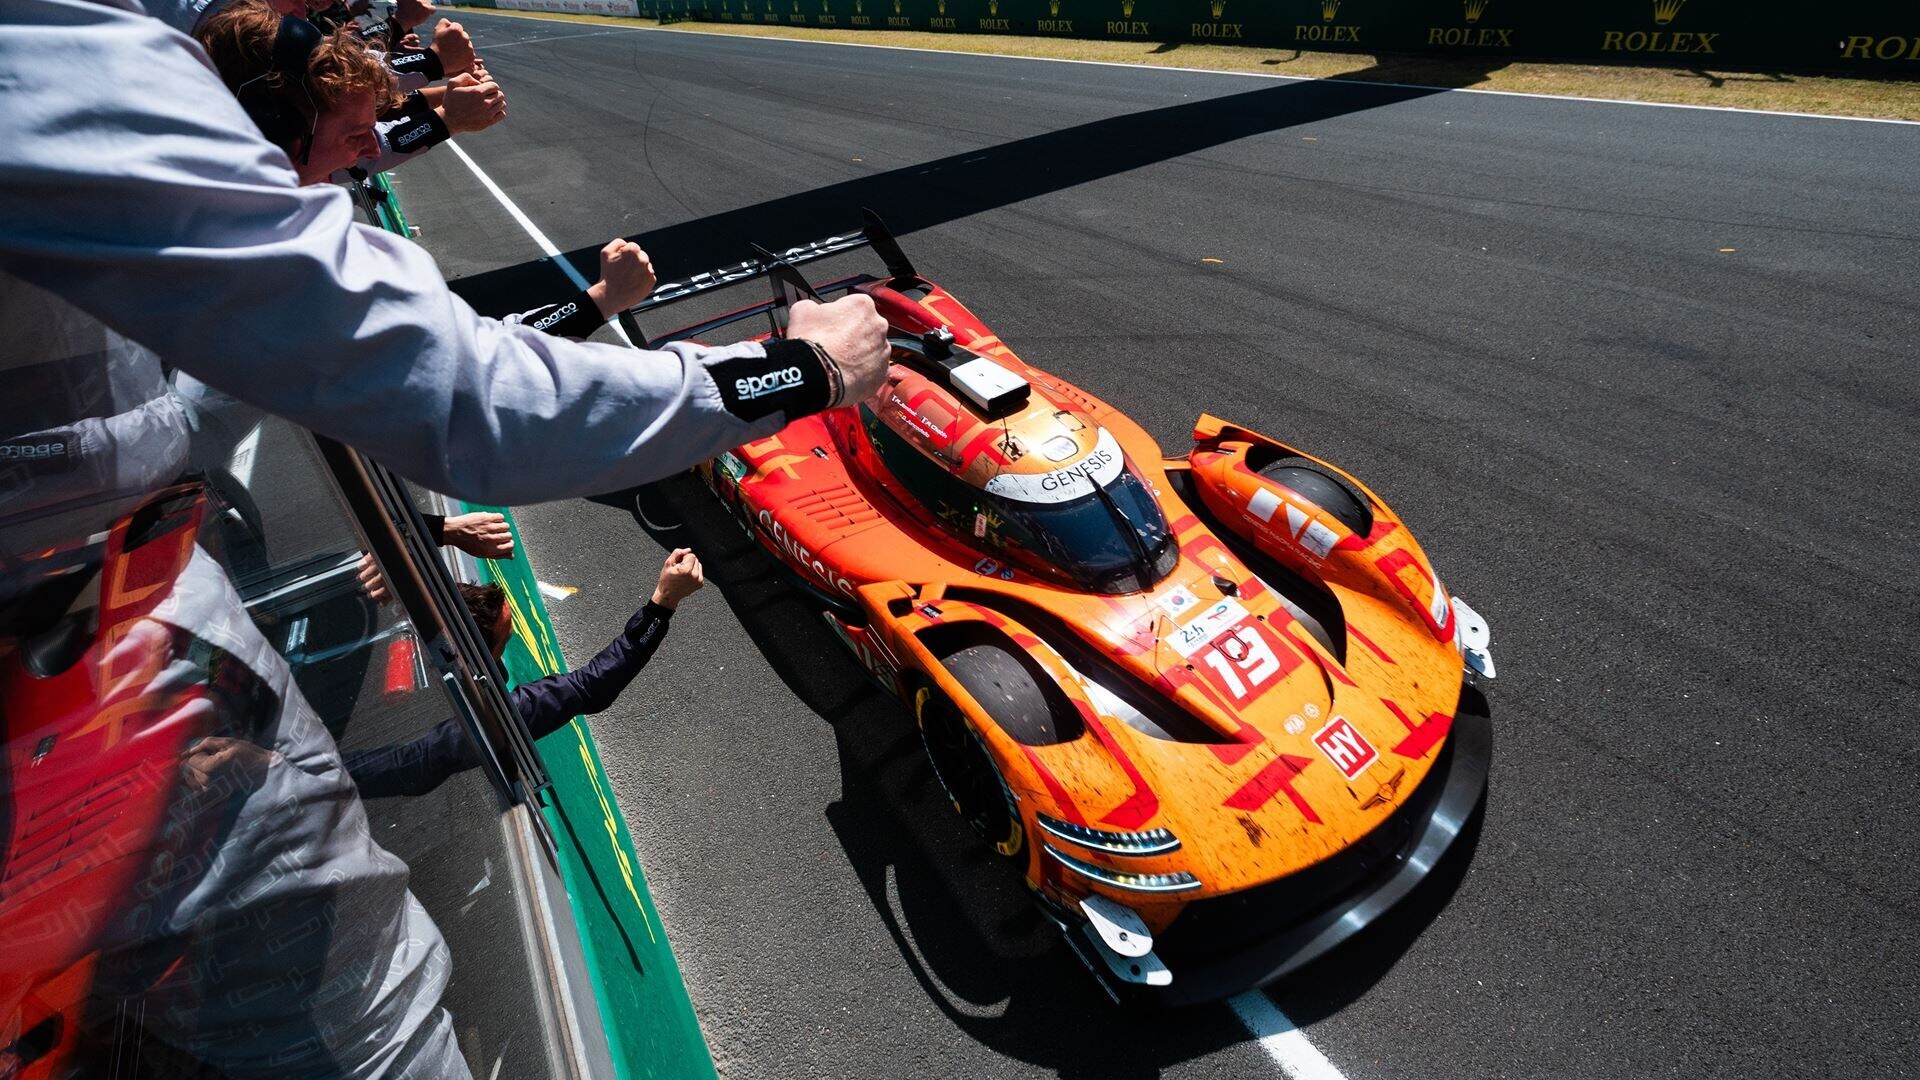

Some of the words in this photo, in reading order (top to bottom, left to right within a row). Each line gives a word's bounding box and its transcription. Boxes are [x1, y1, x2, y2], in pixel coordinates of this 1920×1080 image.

[888, 16, 911, 26] ROLEX
[930, 17, 956, 29] ROLEX
[980, 18, 1010, 30] ROLEX
[1038, 19, 1073, 32] ROLEX
[1107, 21, 1149, 35] ROLEX
[1191, 23, 1243, 39] ROLEX
[1295, 25, 1361, 42] ROLEX
[1428, 28, 1514, 47] ROLEX
[1601, 30, 1720, 54] ROLEX
[398, 122, 432, 146] sparco
[654, 236, 856, 301] GENSIS
[533, 302, 578, 331] sparco
[735, 366, 804, 400] sparco
[1041, 450, 1112, 491] GENESIS
[1203, 626, 1280, 700] 19
[1320, 723, 1366, 771] HY
